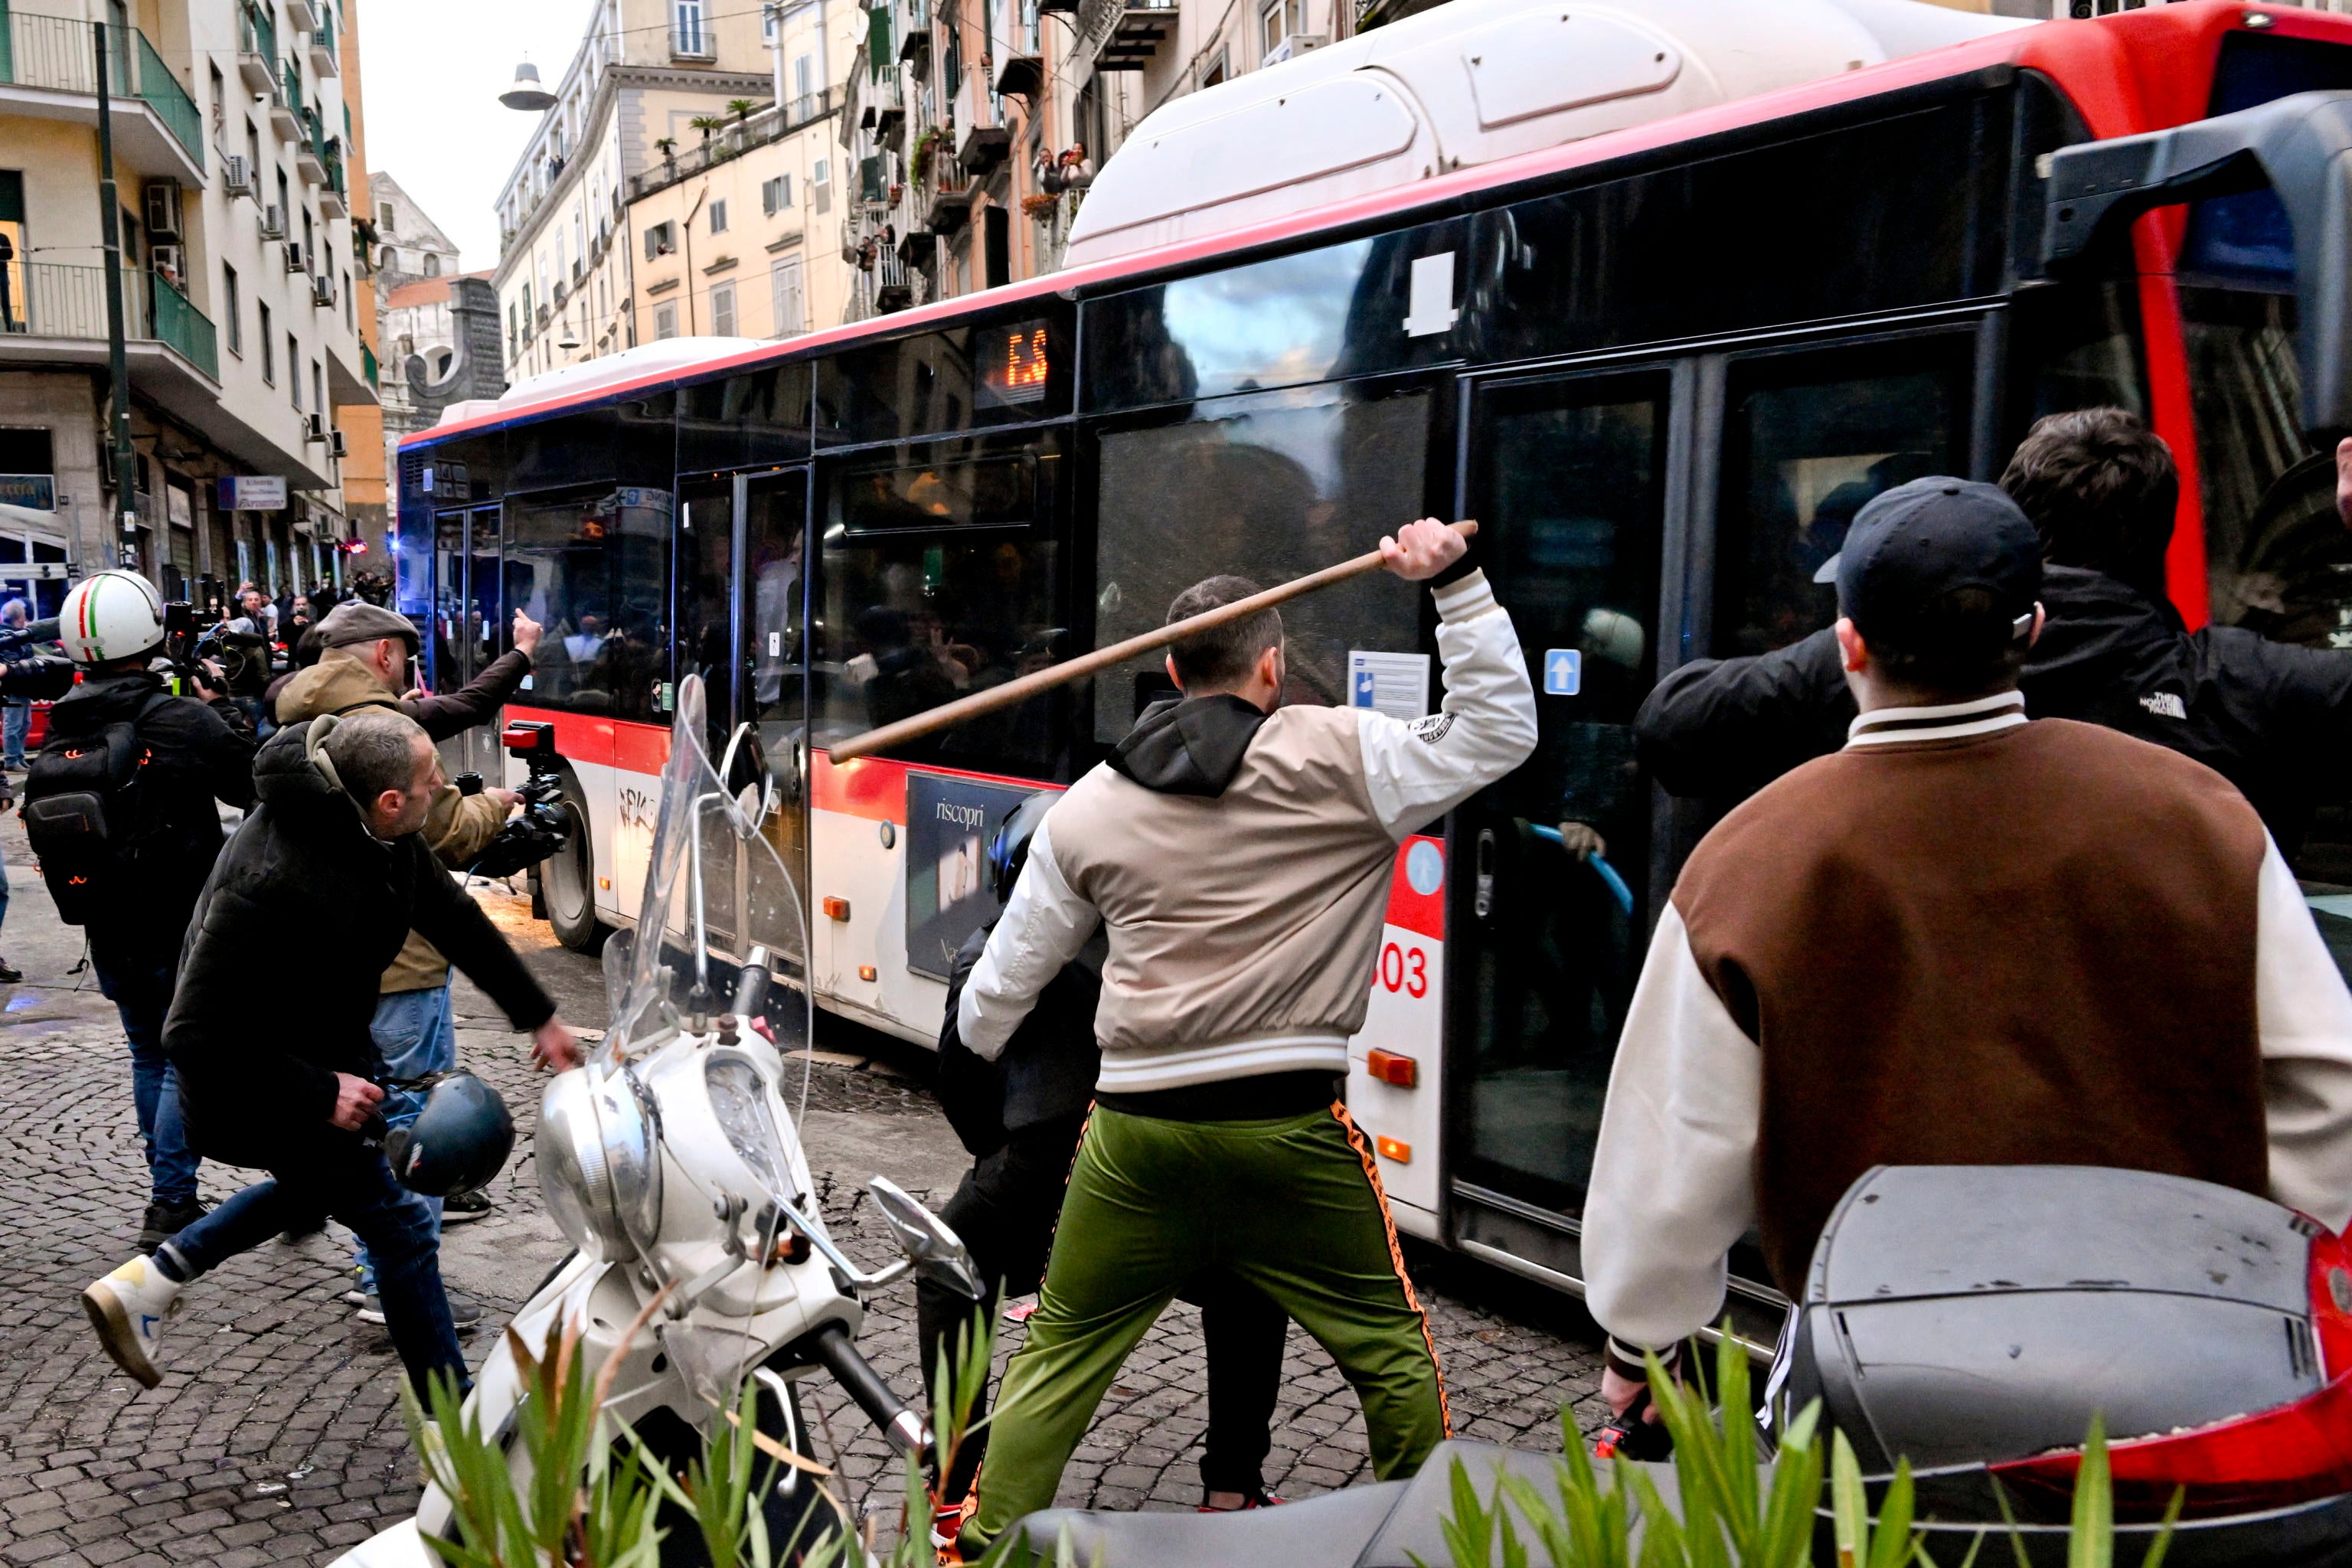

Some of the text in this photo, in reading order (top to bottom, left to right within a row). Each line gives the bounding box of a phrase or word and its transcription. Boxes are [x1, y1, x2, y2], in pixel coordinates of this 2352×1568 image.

[2140, 697, 2173, 709] NORTH
[936, 797, 985, 831] riscopri
[1370, 942, 1427, 998] 03
